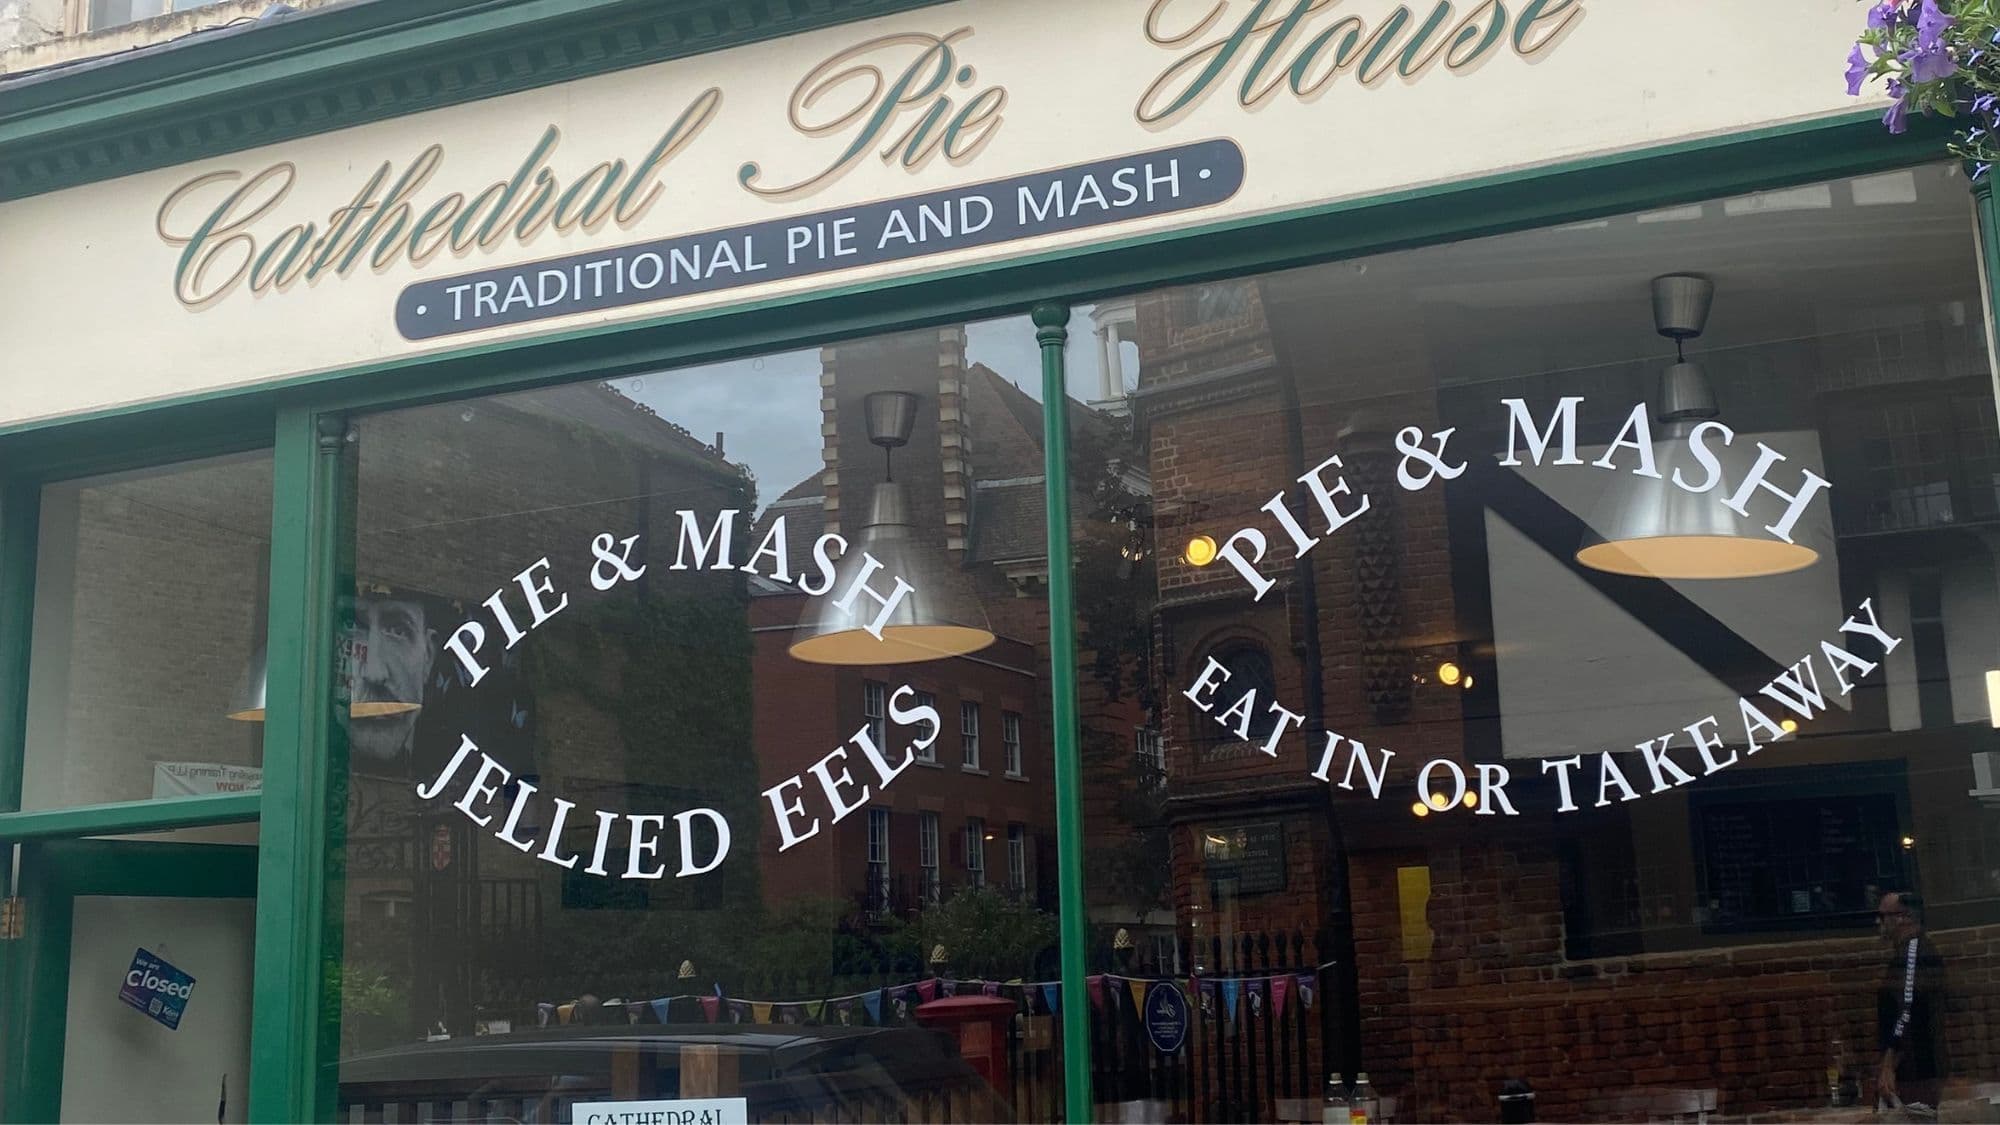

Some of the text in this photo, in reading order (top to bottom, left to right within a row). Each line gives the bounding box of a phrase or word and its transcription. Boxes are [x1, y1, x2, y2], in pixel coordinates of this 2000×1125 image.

[156, 0, 1588, 307] Cathedral Pie House
[446, 158, 1181, 321] TRADITIONAL PIE AND MASH
[1216, 395, 1832, 602] PIE & MASH
[443, 508, 915, 688] PIE & MASH
[416, 684, 941, 879] JELLIED EELS
[1183, 597, 1903, 816] EAT IN OR TAKEAWAY
[127, 969, 193, 1000] Closed
